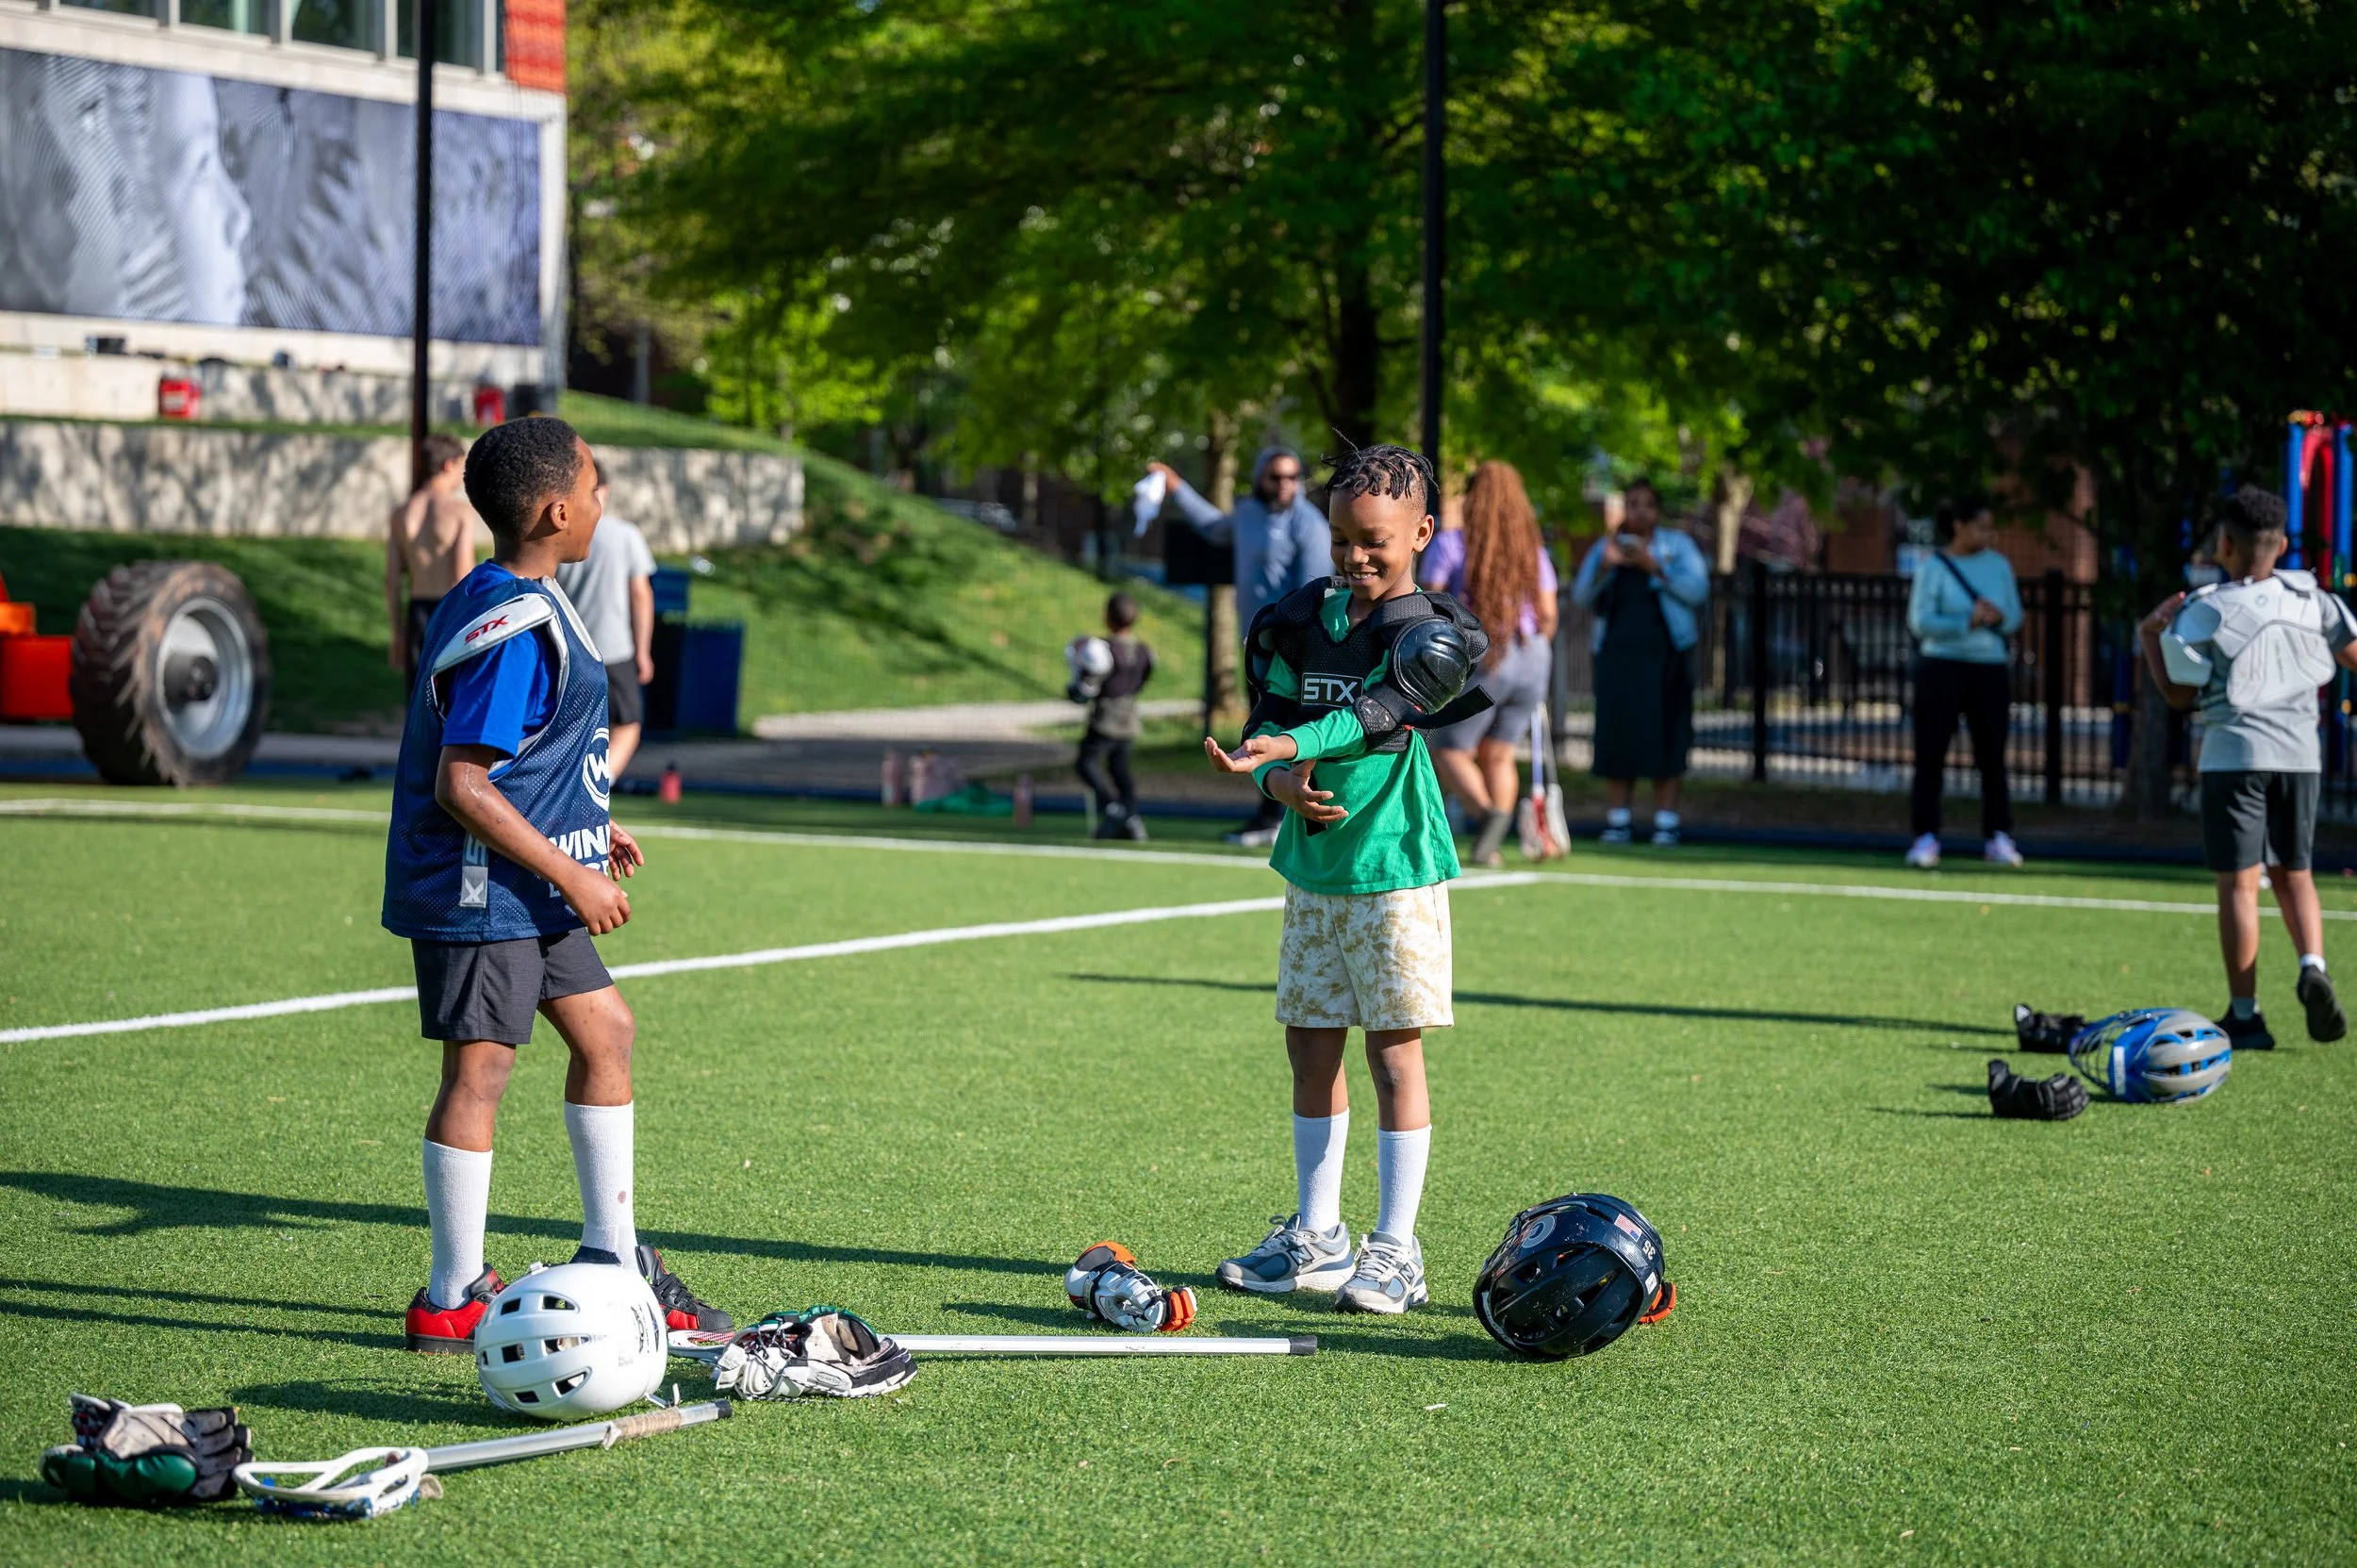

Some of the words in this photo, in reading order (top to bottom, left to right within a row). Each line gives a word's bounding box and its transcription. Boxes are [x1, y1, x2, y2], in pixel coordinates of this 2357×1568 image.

[465, 614, 509, 646] STX
[1304, 678, 1358, 704] STX
[1642, 1239, 1656, 1261] 35
